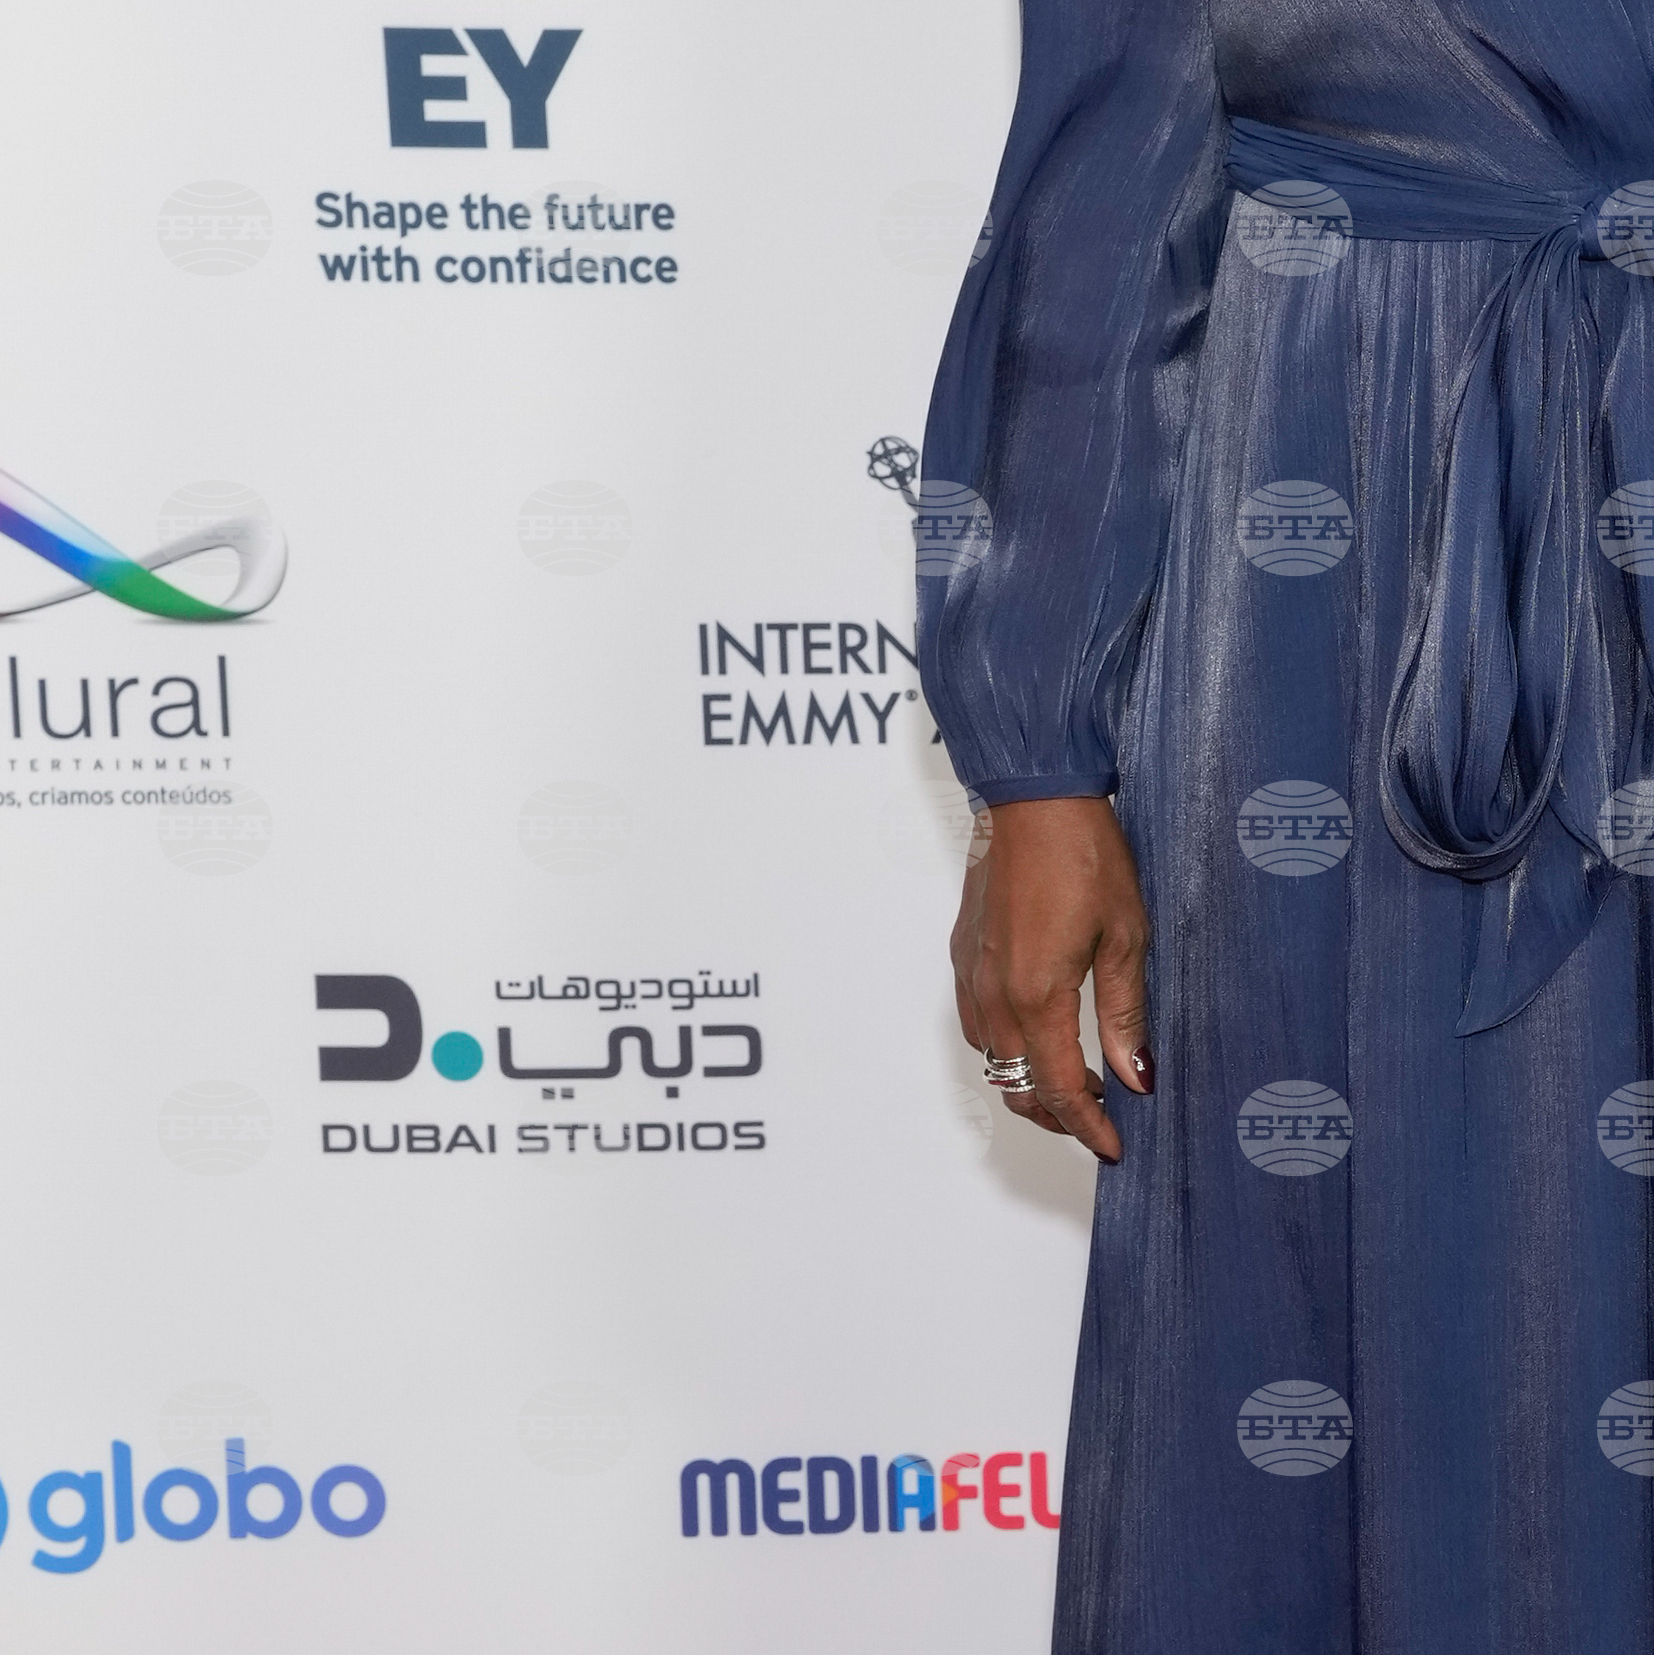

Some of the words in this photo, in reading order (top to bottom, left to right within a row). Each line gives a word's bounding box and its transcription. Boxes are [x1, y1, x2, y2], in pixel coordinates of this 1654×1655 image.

[382, 26, 584, 150] EY
[314, 190, 449, 237] Shape
[459, 193, 532, 231] the
[543, 193, 676, 232] future
[318, 245, 421, 283] with
[434, 246, 679, 285] confidence
[698, 619, 920, 677] INTERN
[8, 654, 231, 741] lural
[9, 757, 231, 772] TERTAINMENT
[28, 787, 115, 807] criamos
[321, 1123, 497, 1154] DUBAI
[517, 1120, 767, 1154] STUDIOS
[27, 1437, 387, 1575] globo
[679, 1452, 1061, 1538] MEDIAFEL
